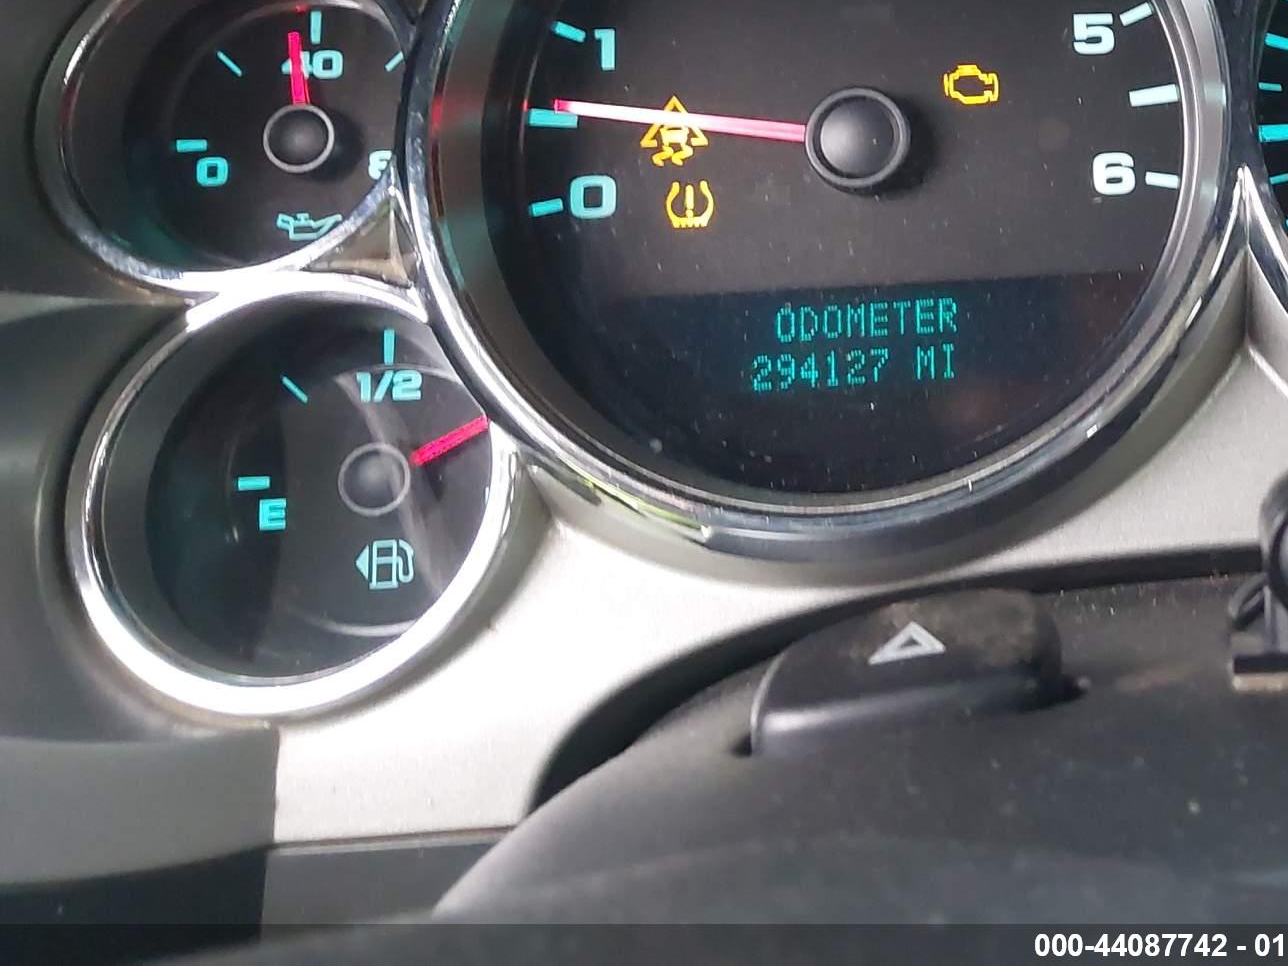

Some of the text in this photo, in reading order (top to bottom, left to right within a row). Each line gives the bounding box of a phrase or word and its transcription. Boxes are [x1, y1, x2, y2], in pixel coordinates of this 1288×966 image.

[594, 28, 616, 71] 1
[1073, 13, 1115, 55] 5
[196, 156, 229, 188] 0
[1092, 151, 1137, 196] 6
[569, 174, 618, 220] 0
[776, 297, 957, 343] ODOMETER
[356, 370, 422, 404] 1/2
[752, 343, 955, 391] 294127 MI
[258, 497, 287, 531] E
